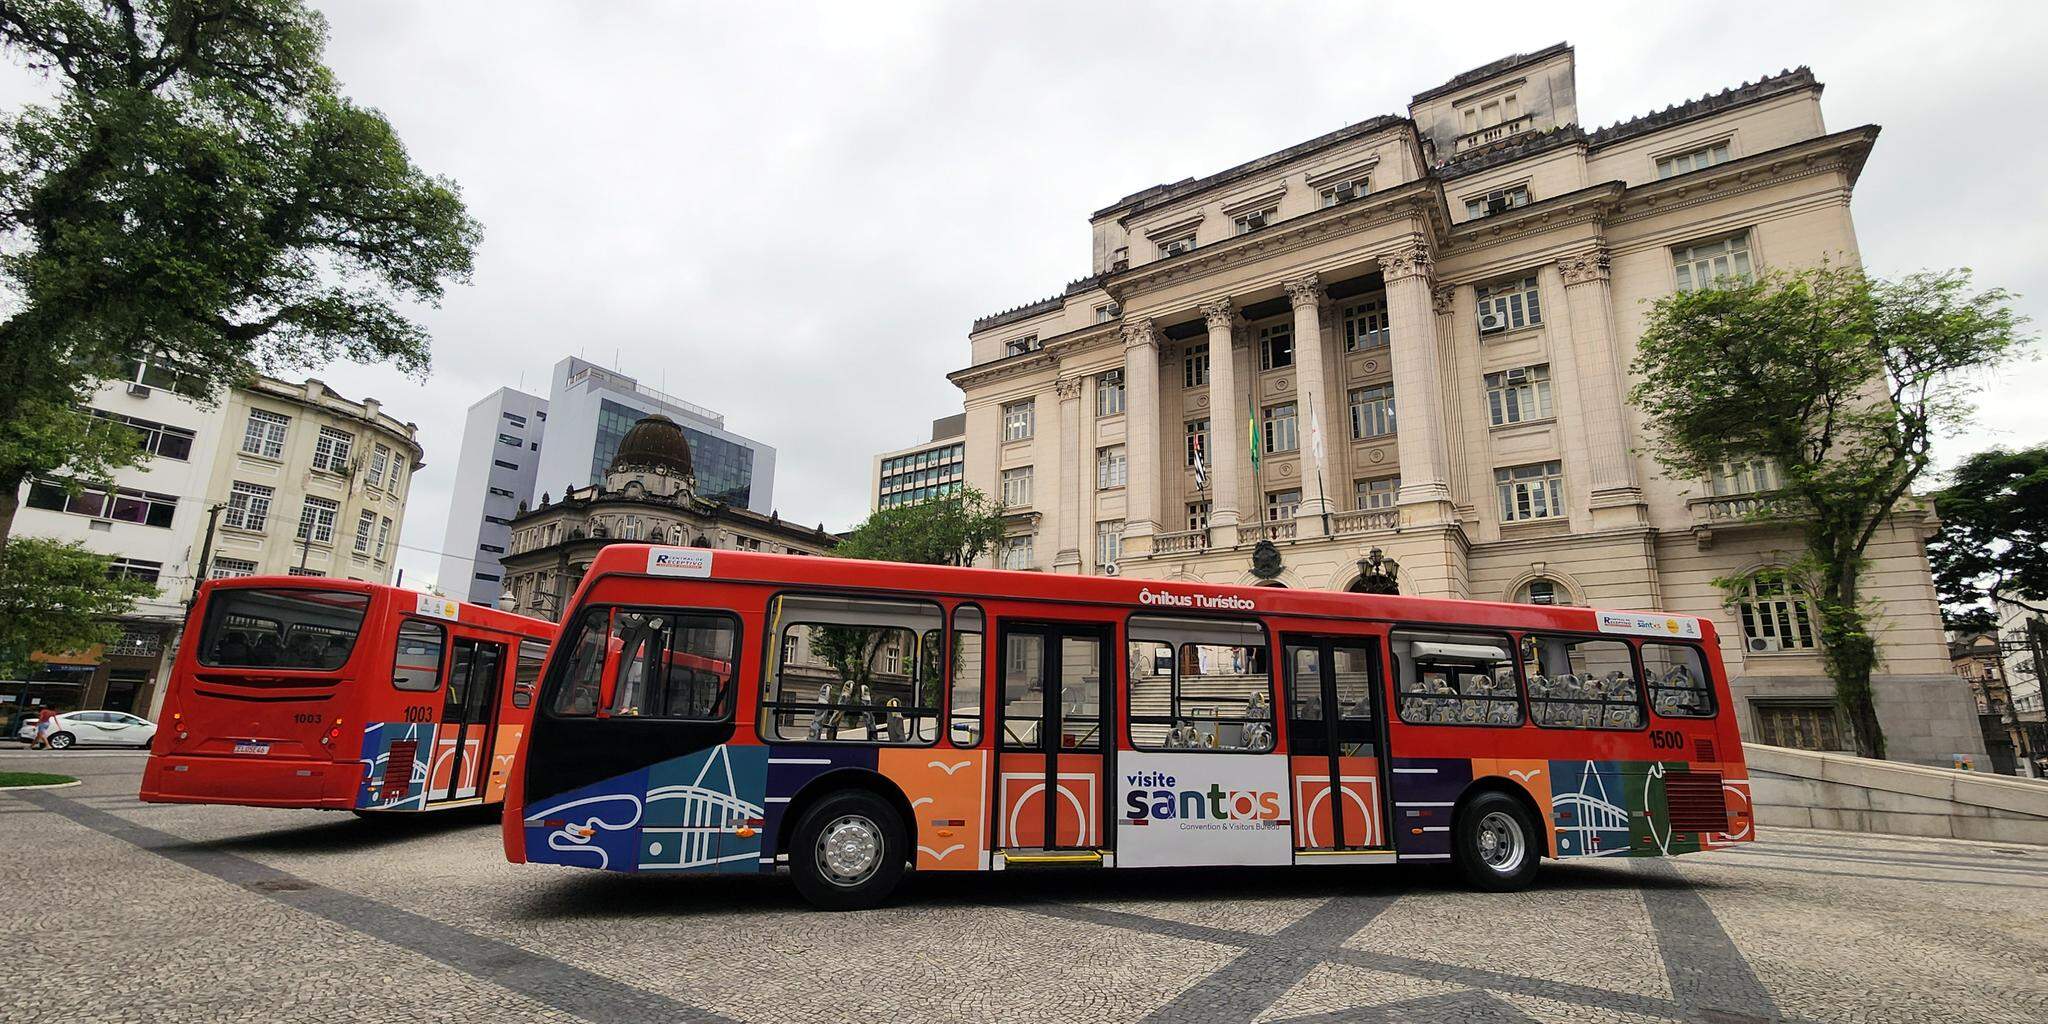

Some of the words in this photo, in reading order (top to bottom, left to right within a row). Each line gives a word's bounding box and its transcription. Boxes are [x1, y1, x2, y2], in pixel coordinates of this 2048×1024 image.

[1139, 587, 1193, 606] Ônibus
[1193, 594, 1255, 610] Turístico
[294, 713, 322, 724] 1003
[404, 705, 433, 723] 1003
[1649, 730, 1684, 750] 1500
[1126, 771, 1176, 787] visite
[1126, 783, 1281, 820] santos
[1180, 823, 1221, 831] Convention
[1229, 823, 1254, 831] Visitors
[1255, 823, 1280, 831] Bureau
